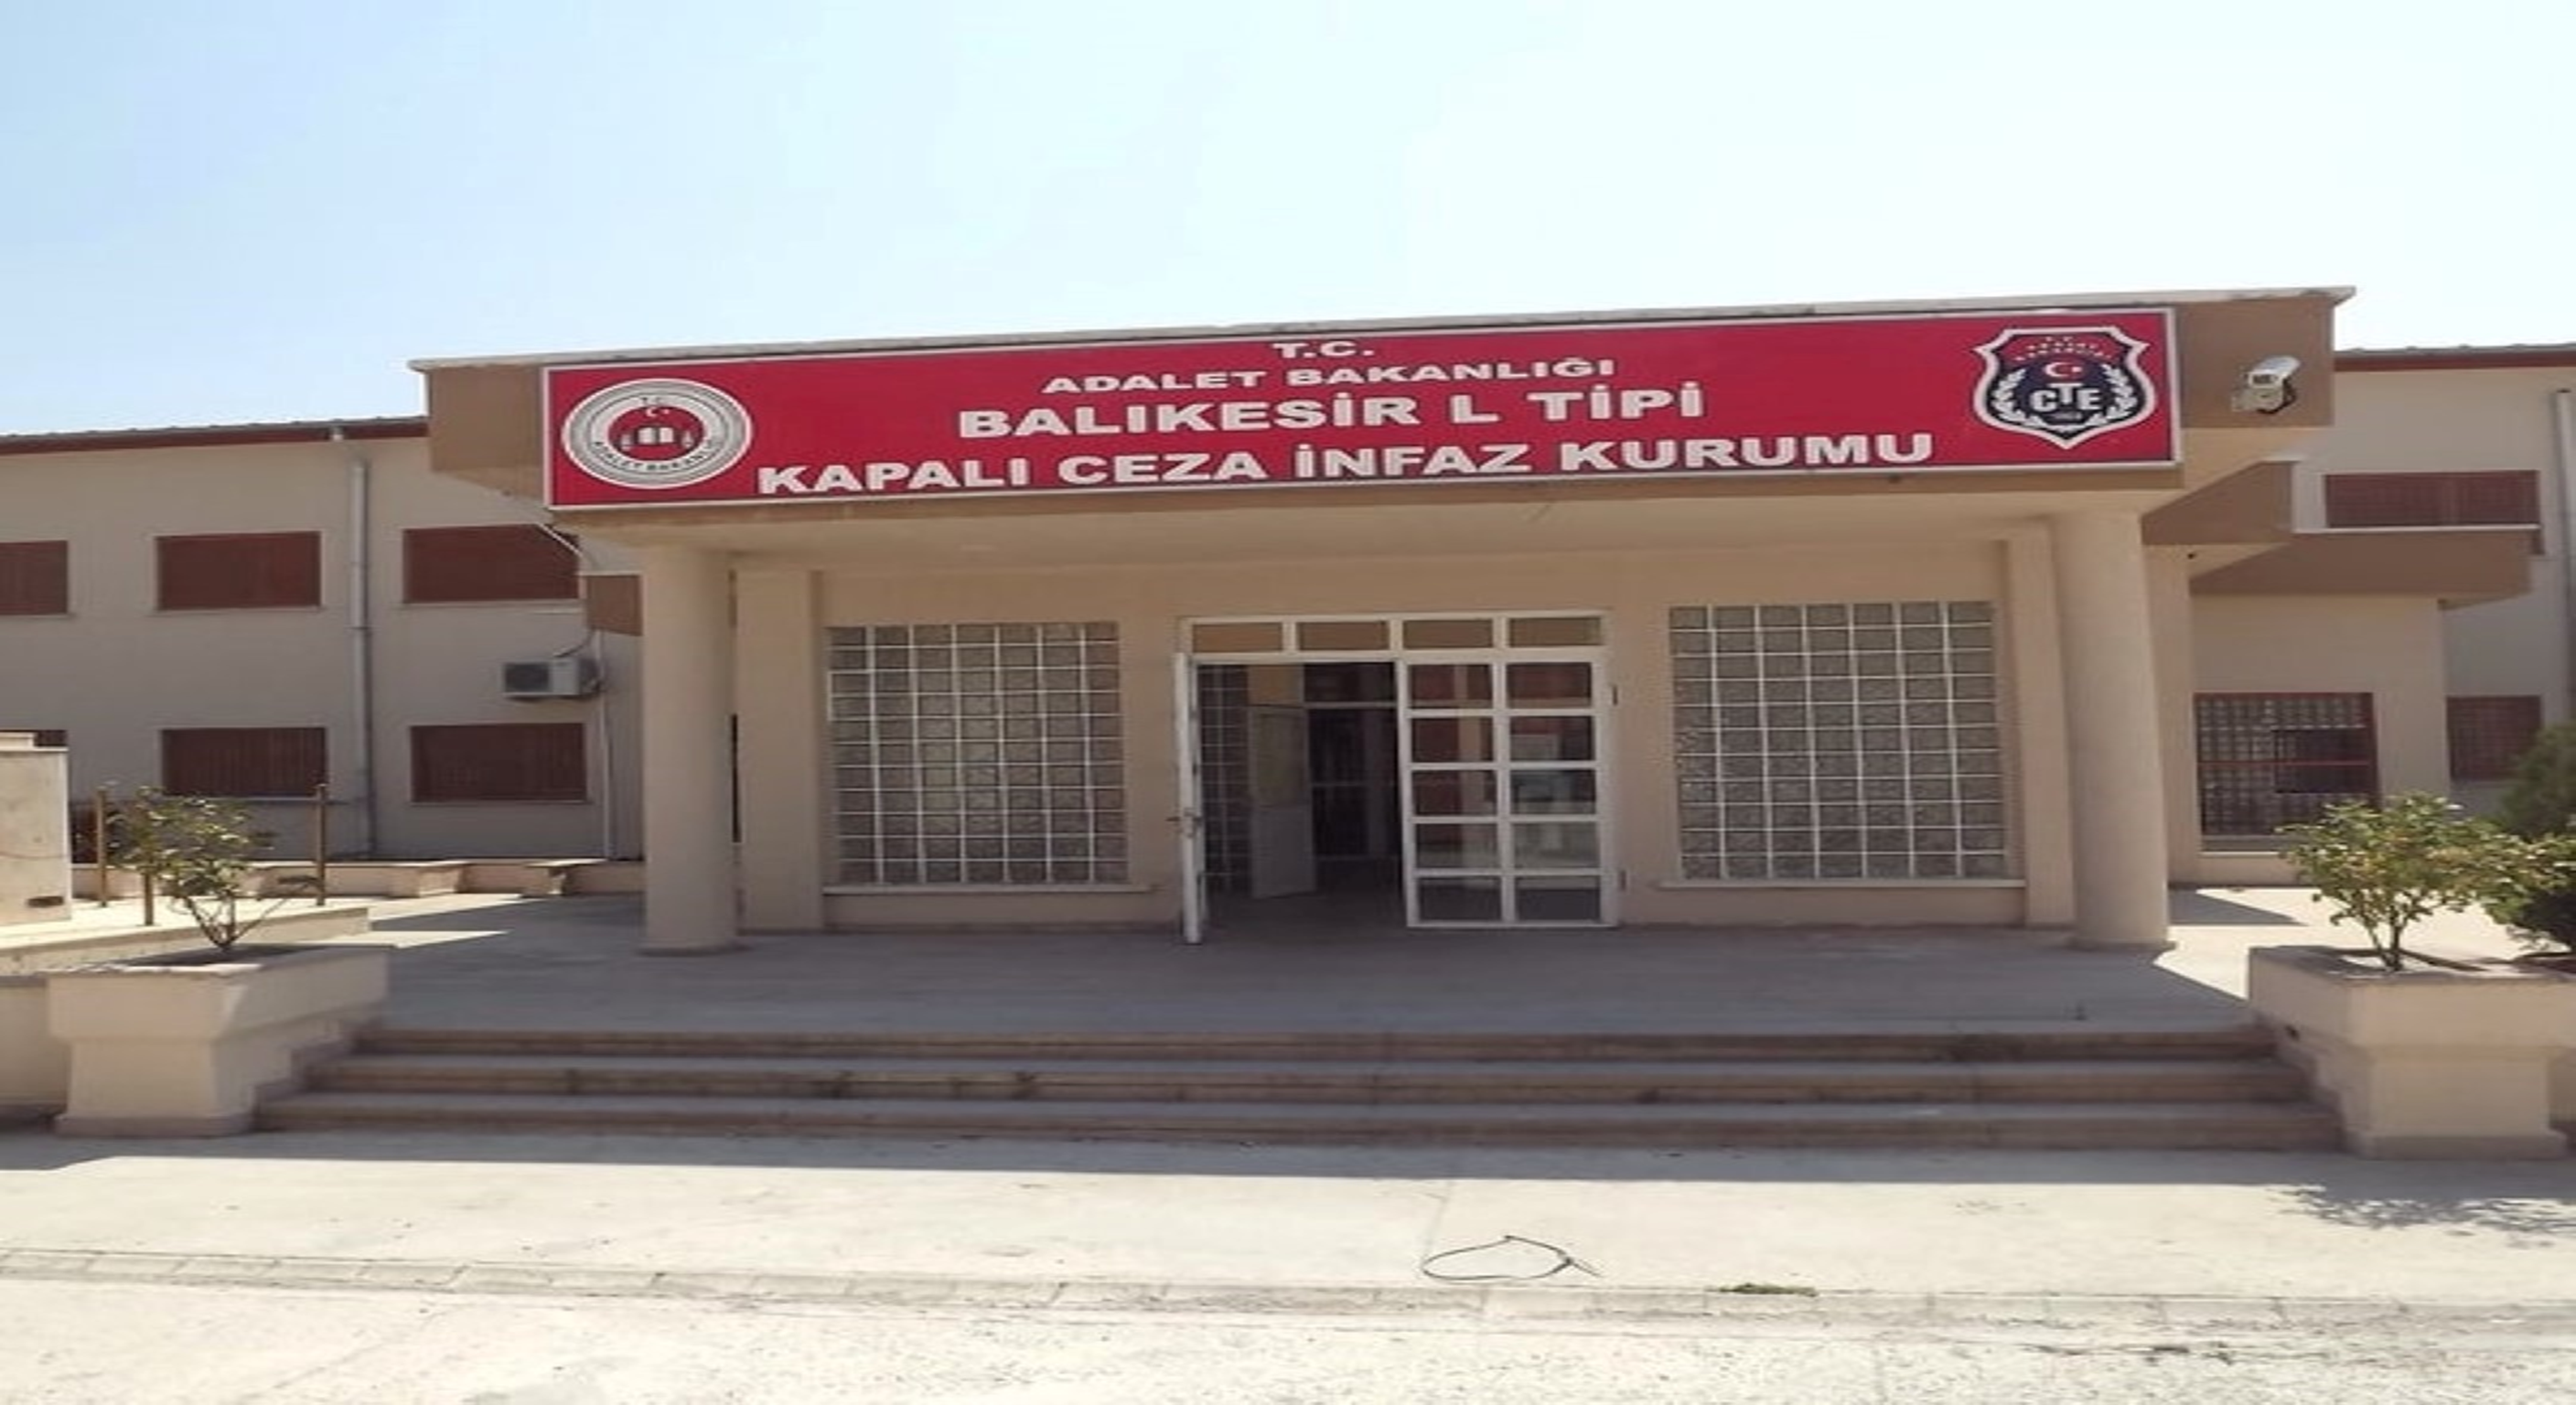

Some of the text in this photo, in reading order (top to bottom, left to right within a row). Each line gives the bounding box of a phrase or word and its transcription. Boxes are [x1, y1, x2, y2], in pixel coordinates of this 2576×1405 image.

[1272, 340, 1374, 359] T.C.
[1042, 358, 1614, 393] ADALET BAKANLIĞI
[960, 381, 1702, 438] BALIKESİR L TİPİ
[2030, 382, 2102, 412] CTE
[758, 434, 1932, 494] KAPALI CEZA İNFAZ KURUMU
